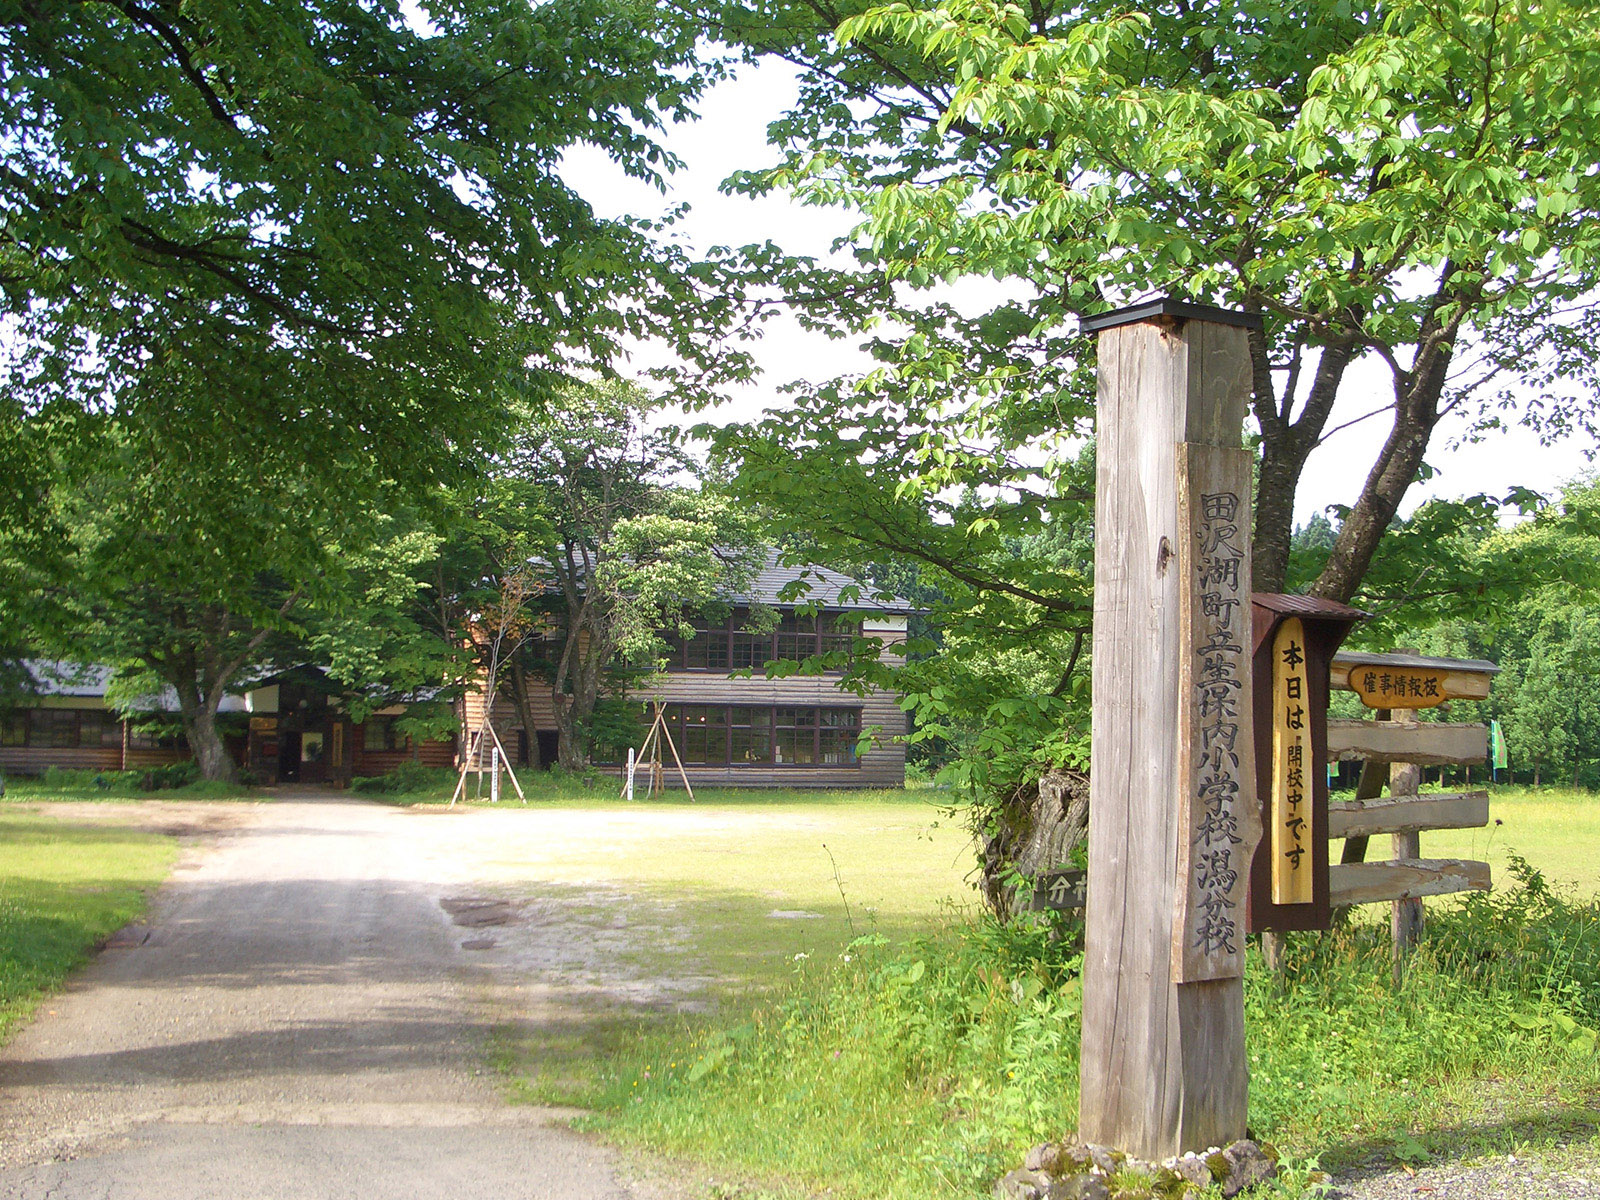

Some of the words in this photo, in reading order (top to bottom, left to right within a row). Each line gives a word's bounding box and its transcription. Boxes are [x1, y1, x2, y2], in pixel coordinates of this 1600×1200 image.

[1193, 492, 1245, 956] 田沢湖町立生保内小学校潟分校
[1282, 640, 1308, 870] 本日は開校中です
[1363, 671, 1440, 698] 催事情報板
